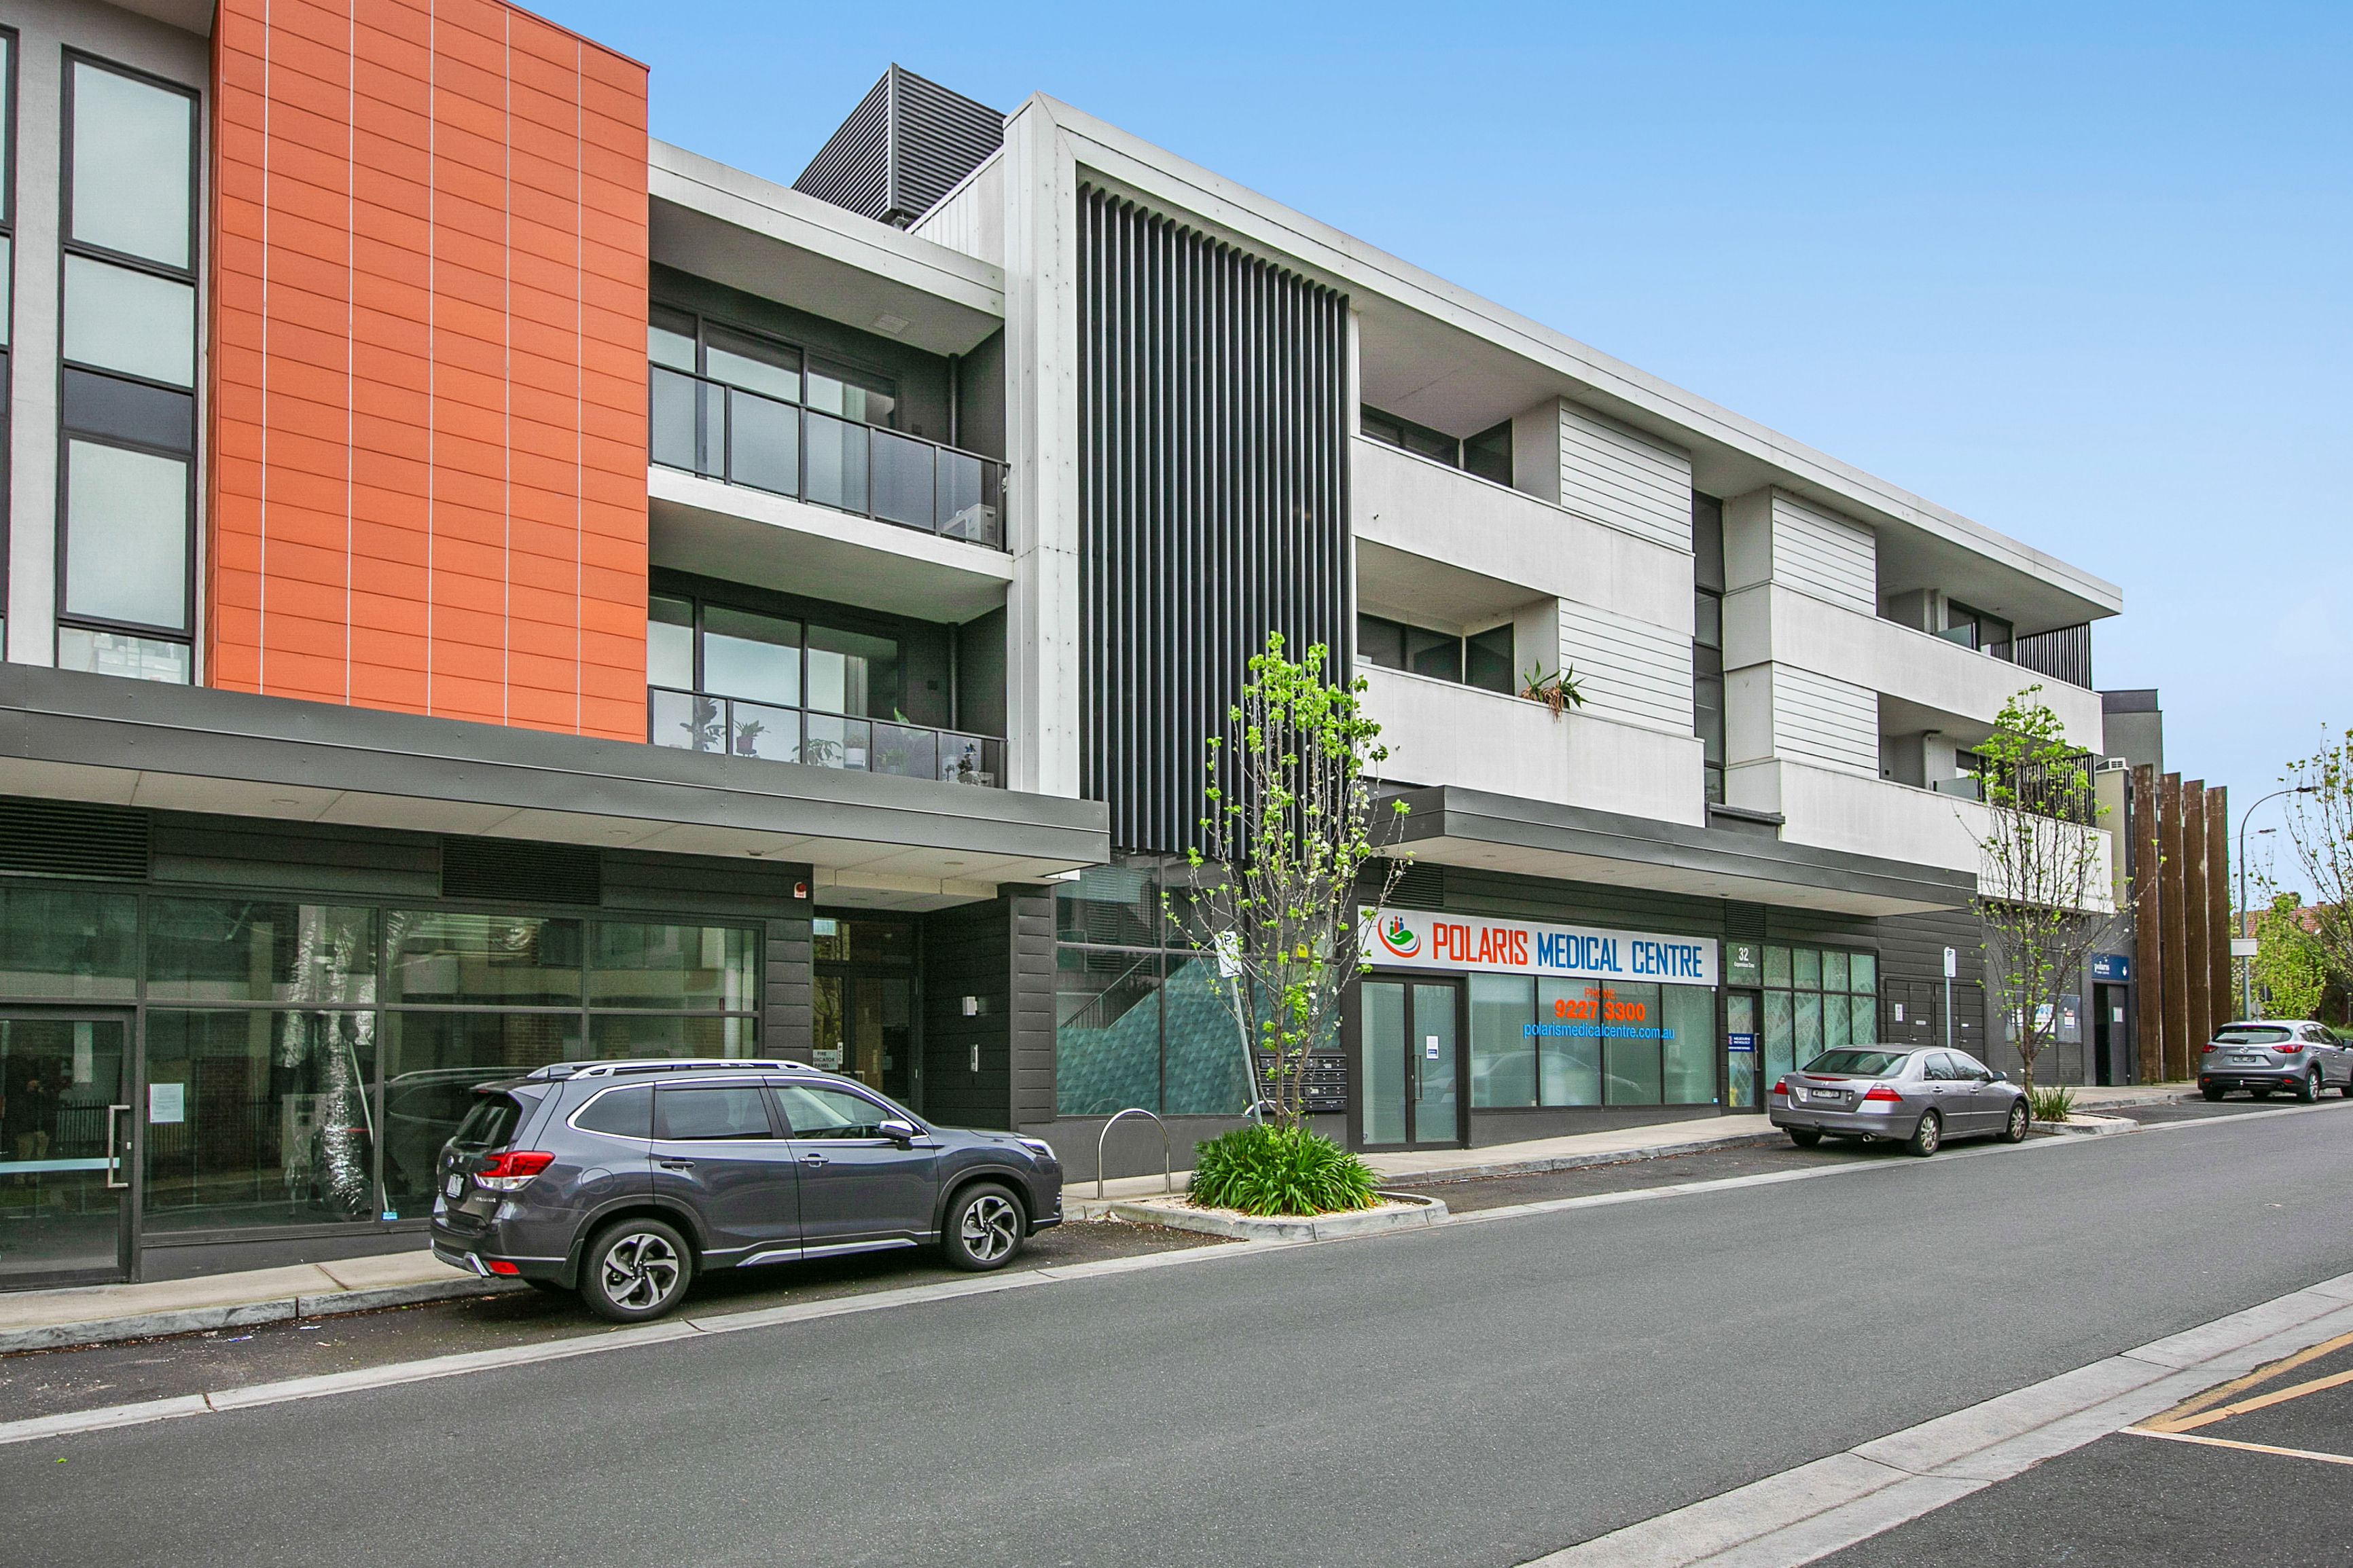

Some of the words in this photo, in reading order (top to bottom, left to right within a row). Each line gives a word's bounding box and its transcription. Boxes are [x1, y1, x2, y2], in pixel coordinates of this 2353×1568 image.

[1433, 922, 1528, 965] POLARIS
[1537, 932, 1623, 972] MEDICAL
[1632, 941, 1702, 977] CENTRE
[1739, 947, 1749, 962] 32
[1554, 999, 1598, 1019] 9227
[1603, 1002, 1646, 1021] 3300
[1523, 1021, 1674, 1040] polarismedicalcentre.com.au
